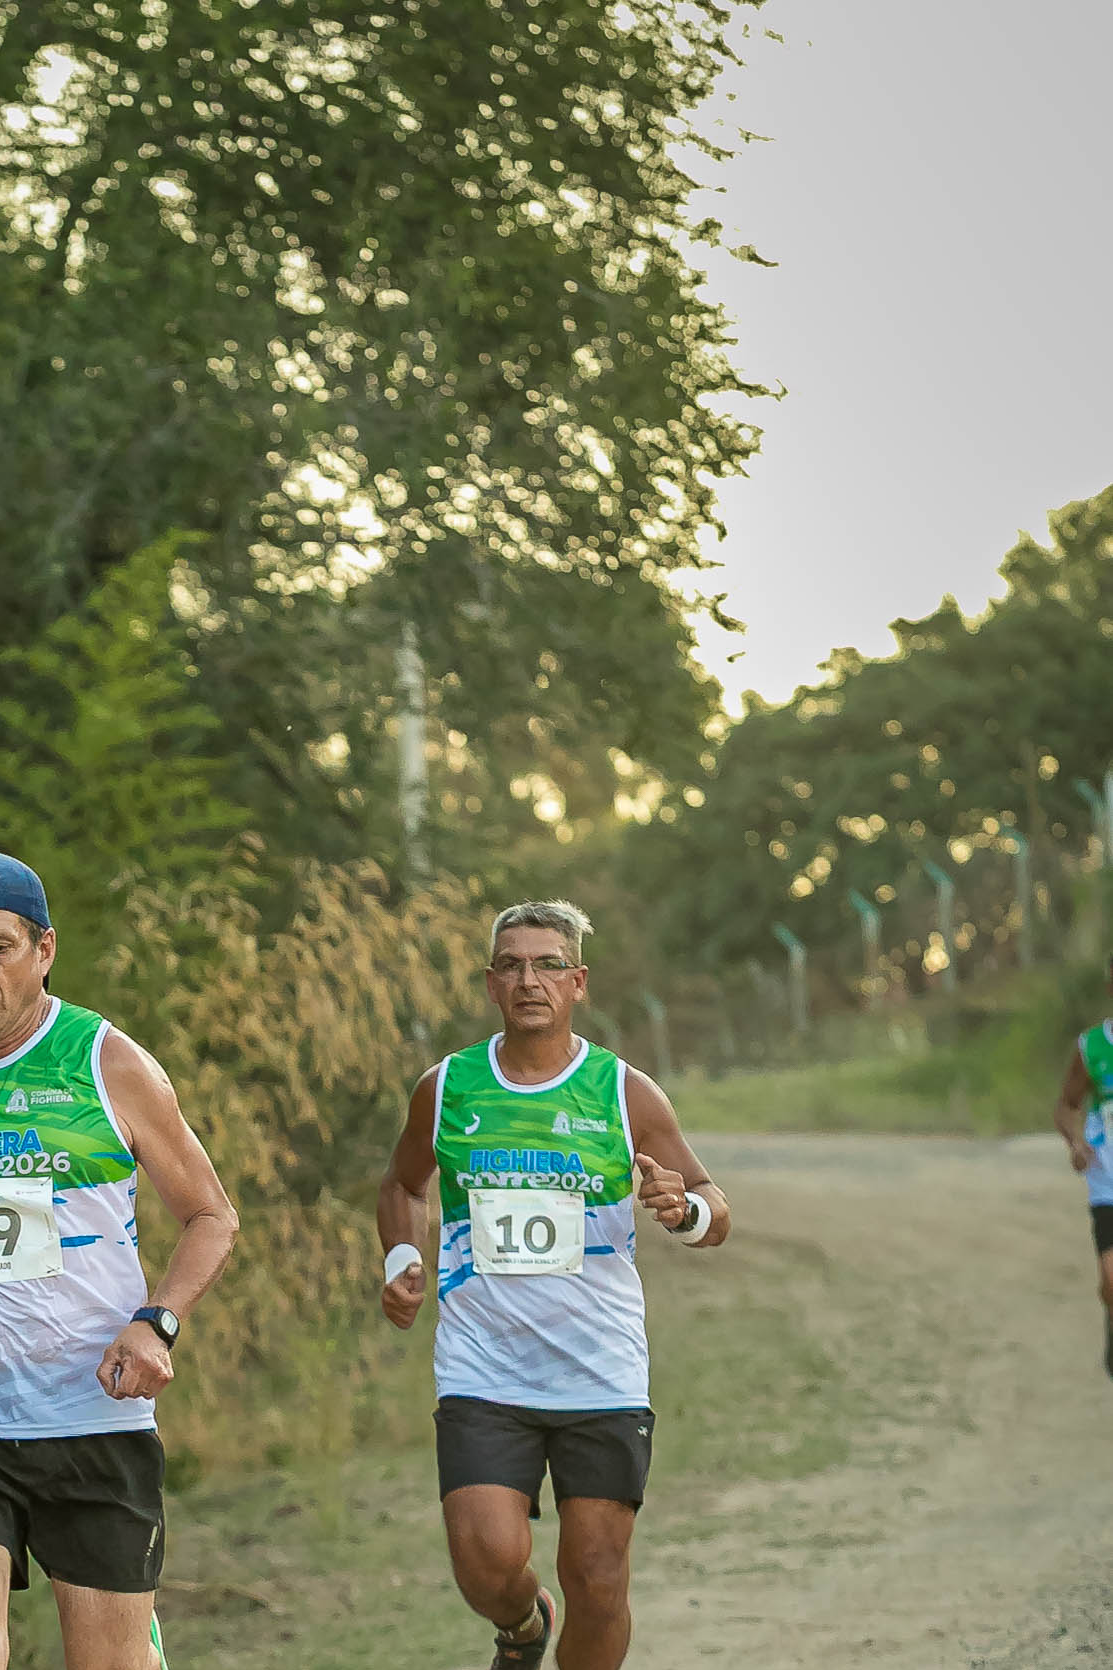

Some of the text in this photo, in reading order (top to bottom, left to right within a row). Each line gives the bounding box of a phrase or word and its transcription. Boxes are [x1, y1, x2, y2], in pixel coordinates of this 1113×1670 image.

[30, 1094, 74, 1105] FIGHIERA
[470, 1148, 586, 1173] FIGHIERA
[495, 1214, 556, 1254] 10
